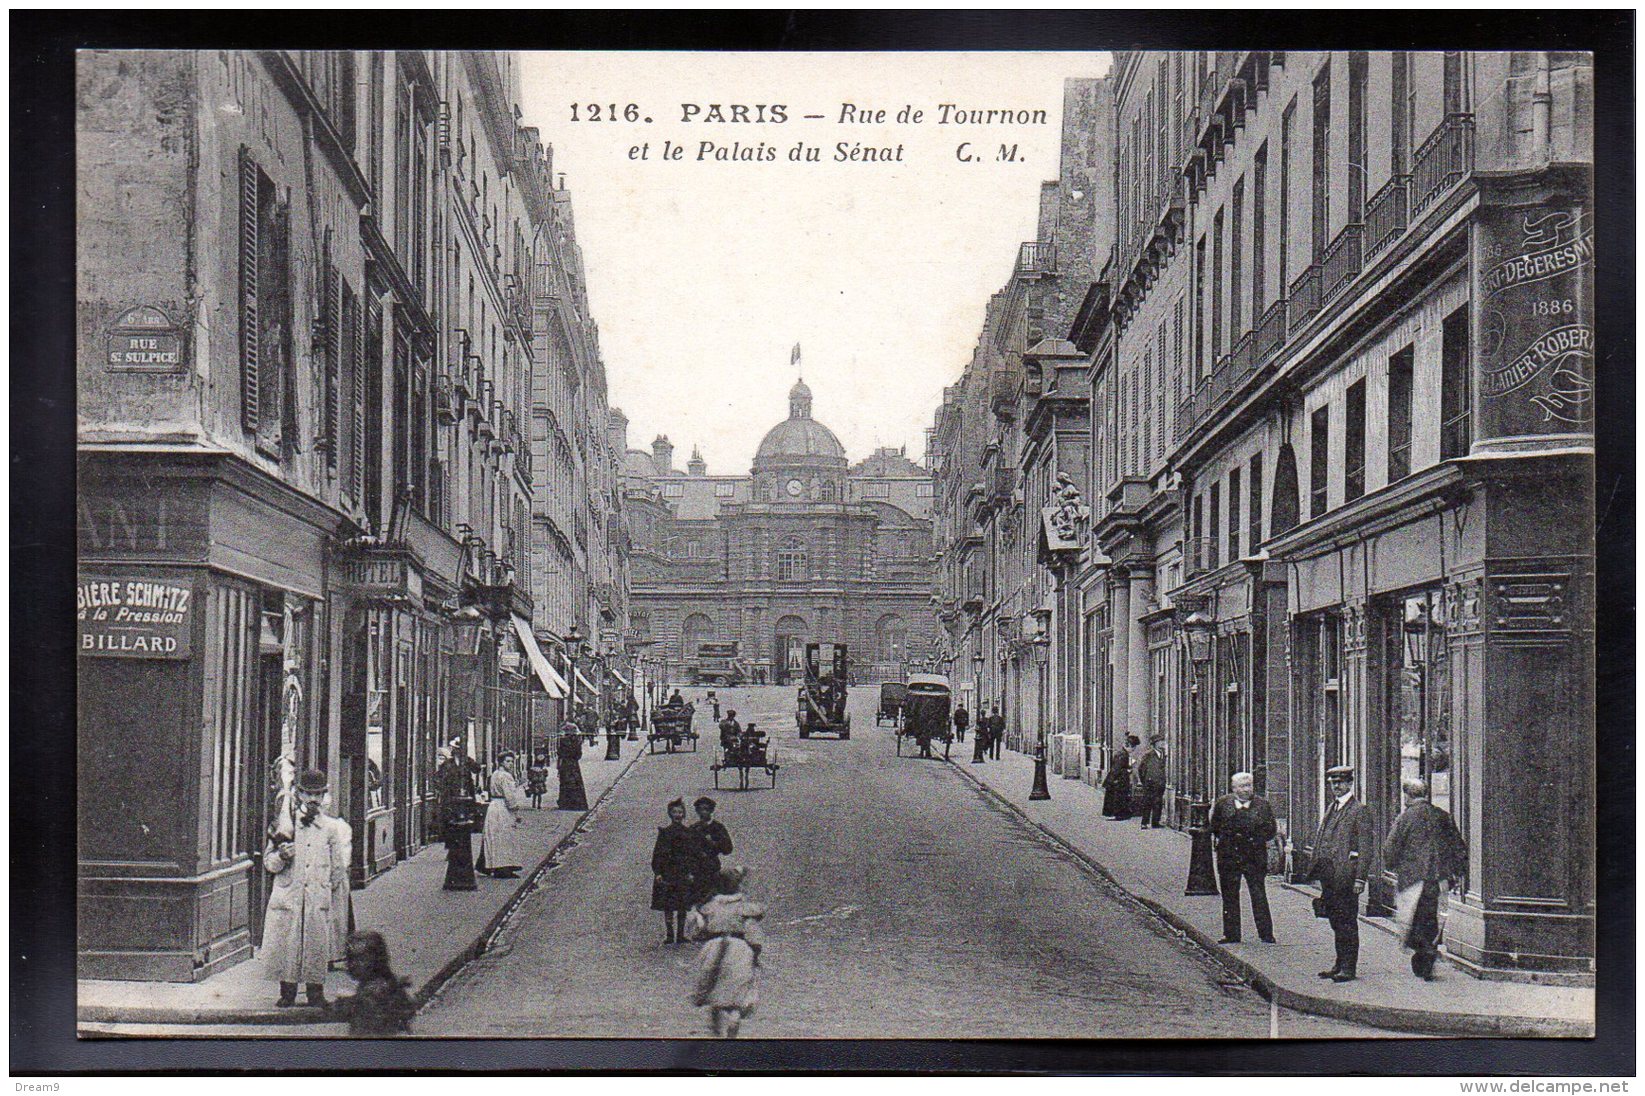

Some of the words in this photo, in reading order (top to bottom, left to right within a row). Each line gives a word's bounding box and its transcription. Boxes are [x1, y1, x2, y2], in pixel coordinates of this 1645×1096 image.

[1532, 300, 1574, 316] 1886
[129, 339, 157, 350] RUE
[126, 352, 176, 362] SULPICE
[93, 607, 108, 620] la
[115, 607, 183, 624] Pression
[82, 633, 177, 652] BILLARD
